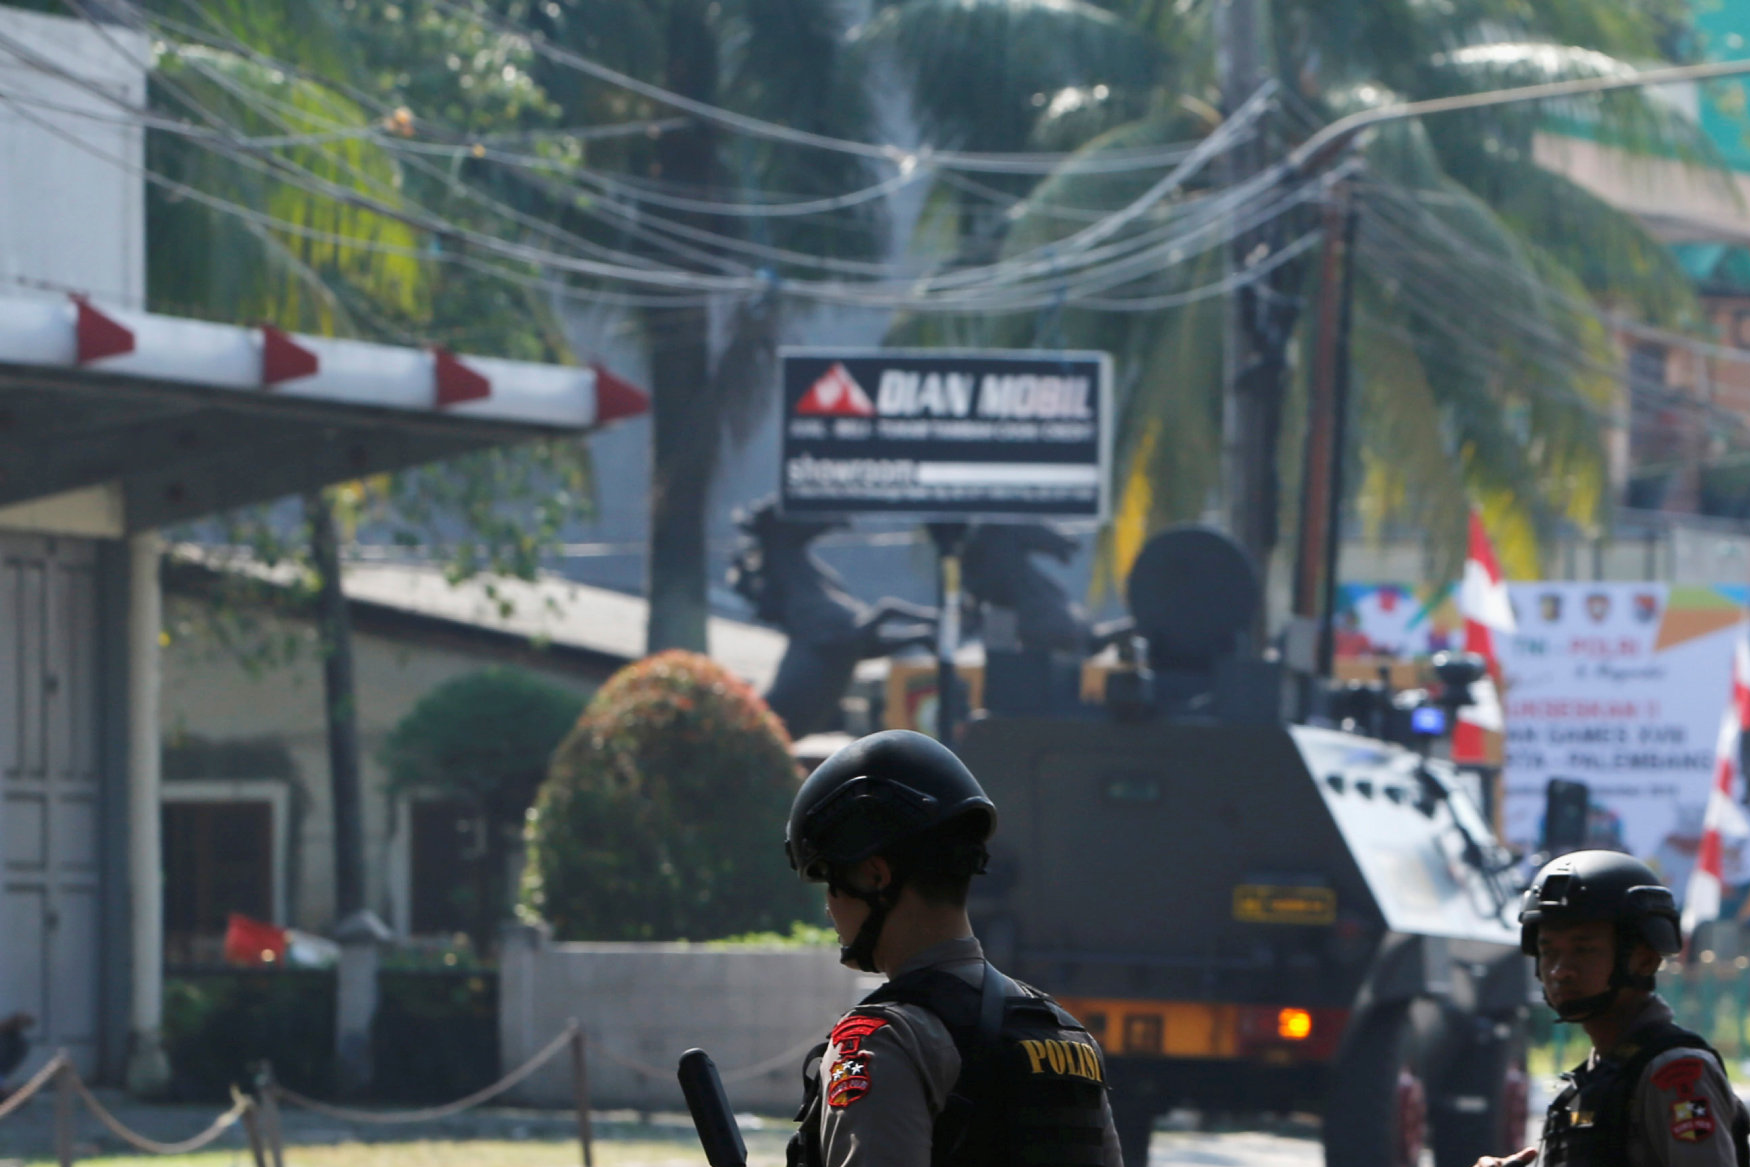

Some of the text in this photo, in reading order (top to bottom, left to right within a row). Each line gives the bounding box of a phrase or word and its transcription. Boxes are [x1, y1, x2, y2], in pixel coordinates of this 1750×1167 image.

[877, 368, 1092, 419] DIAN MOBIL
[1549, 726, 1627, 744] GAMES
[1019, 1039, 1102, 1083] POLISI
